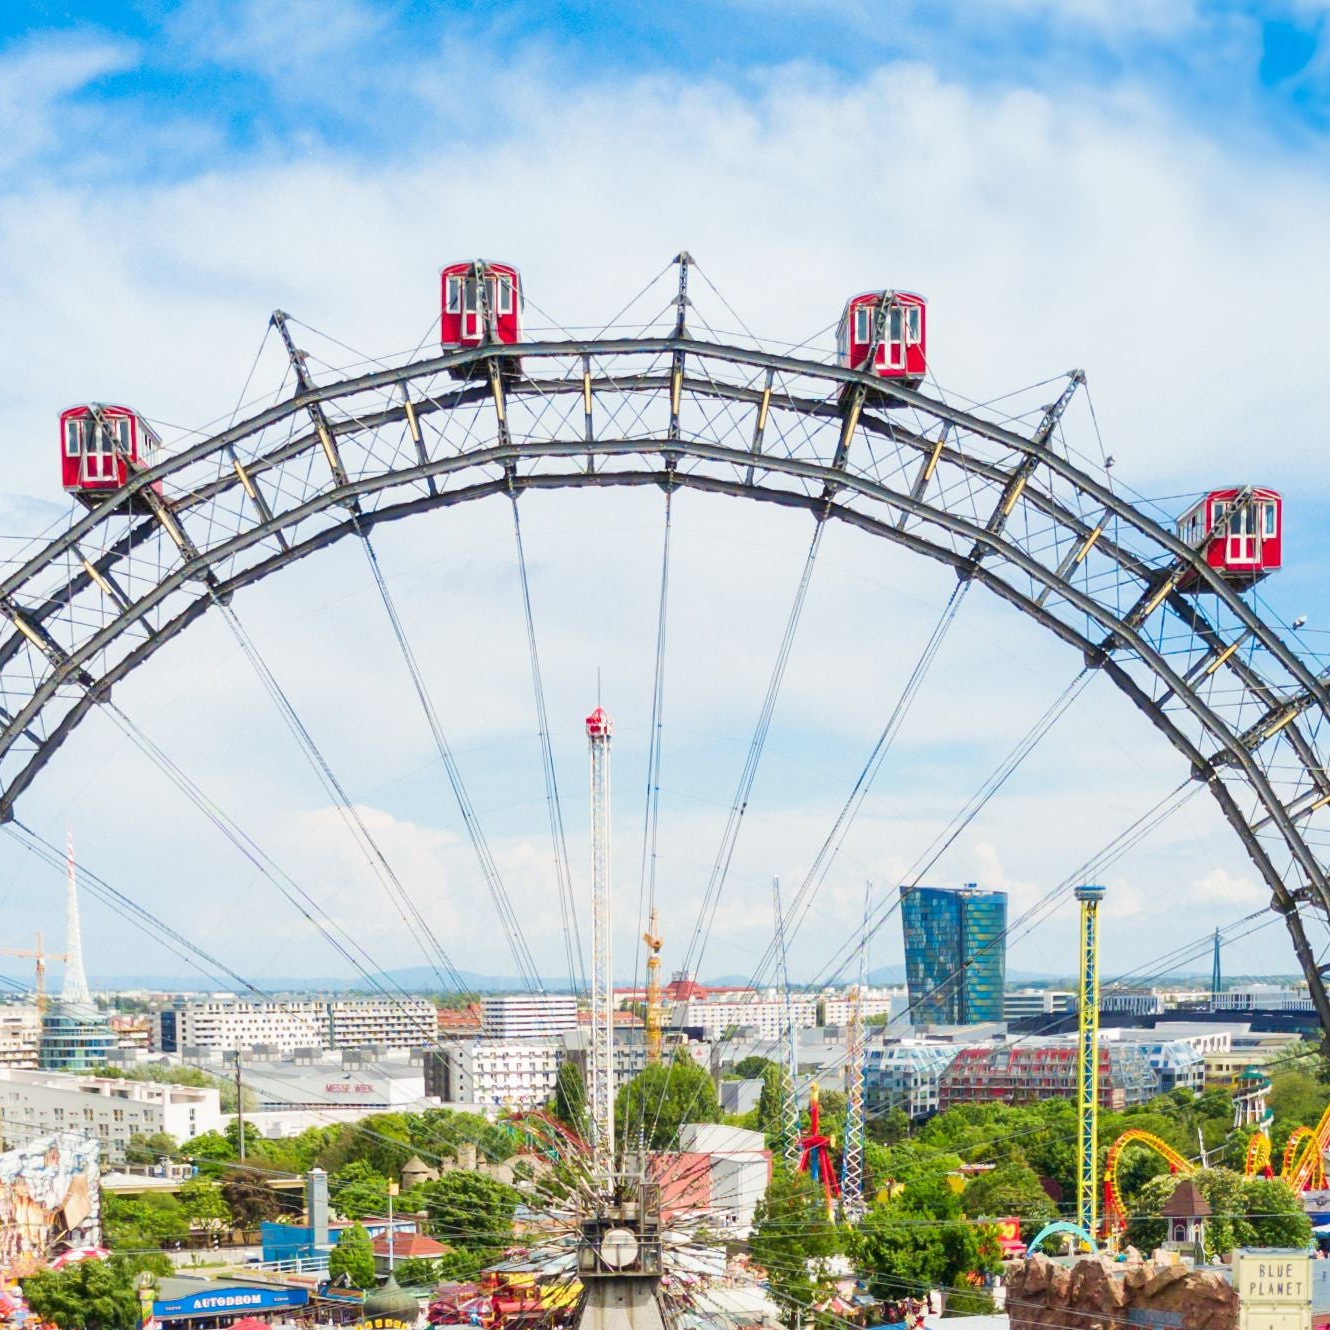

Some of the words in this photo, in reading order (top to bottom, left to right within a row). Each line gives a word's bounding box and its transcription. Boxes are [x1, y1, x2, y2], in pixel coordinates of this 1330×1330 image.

[325, 1083, 349, 1093] MESSE
[354, 1083, 374, 1093] WIEN
[1258, 1263, 1293, 1279] BLUE
[1249, 1281, 1303, 1297] PLANET
[193, 1293, 262, 1310] AUTODROM
